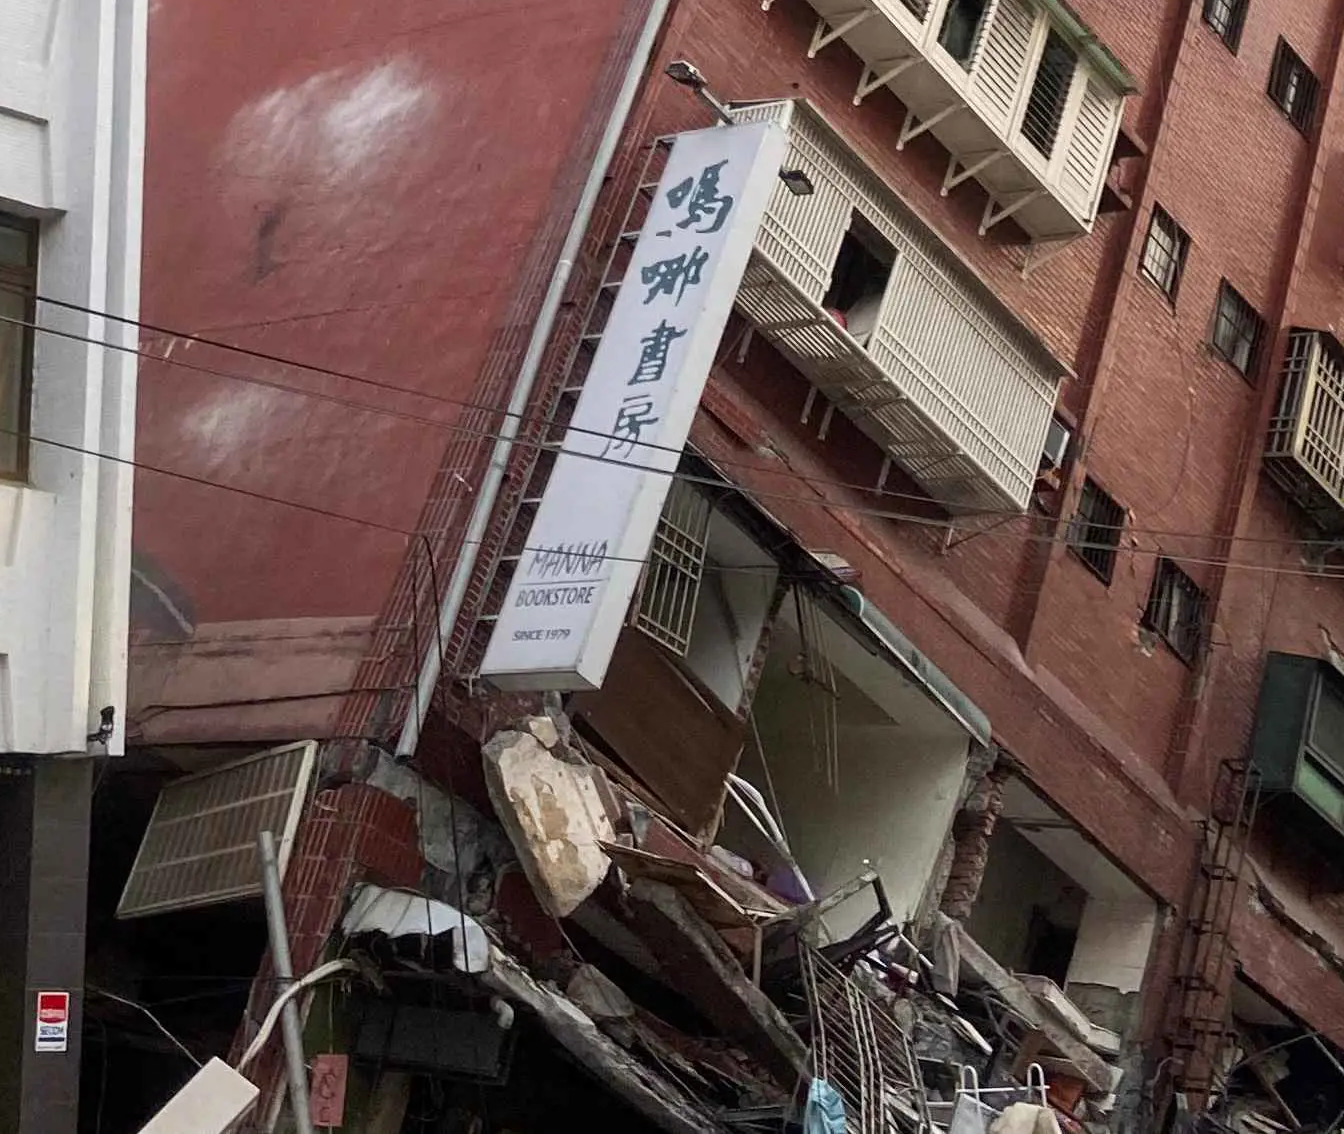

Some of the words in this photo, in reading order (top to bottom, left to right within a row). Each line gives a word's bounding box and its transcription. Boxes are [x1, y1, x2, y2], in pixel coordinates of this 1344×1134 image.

[527, 539, 608, 578] MANNA
[515, 586, 597, 607] BOOKSTORE
[512, 629, 544, 641] SINCE
[544, 628, 571, 640] 1979
